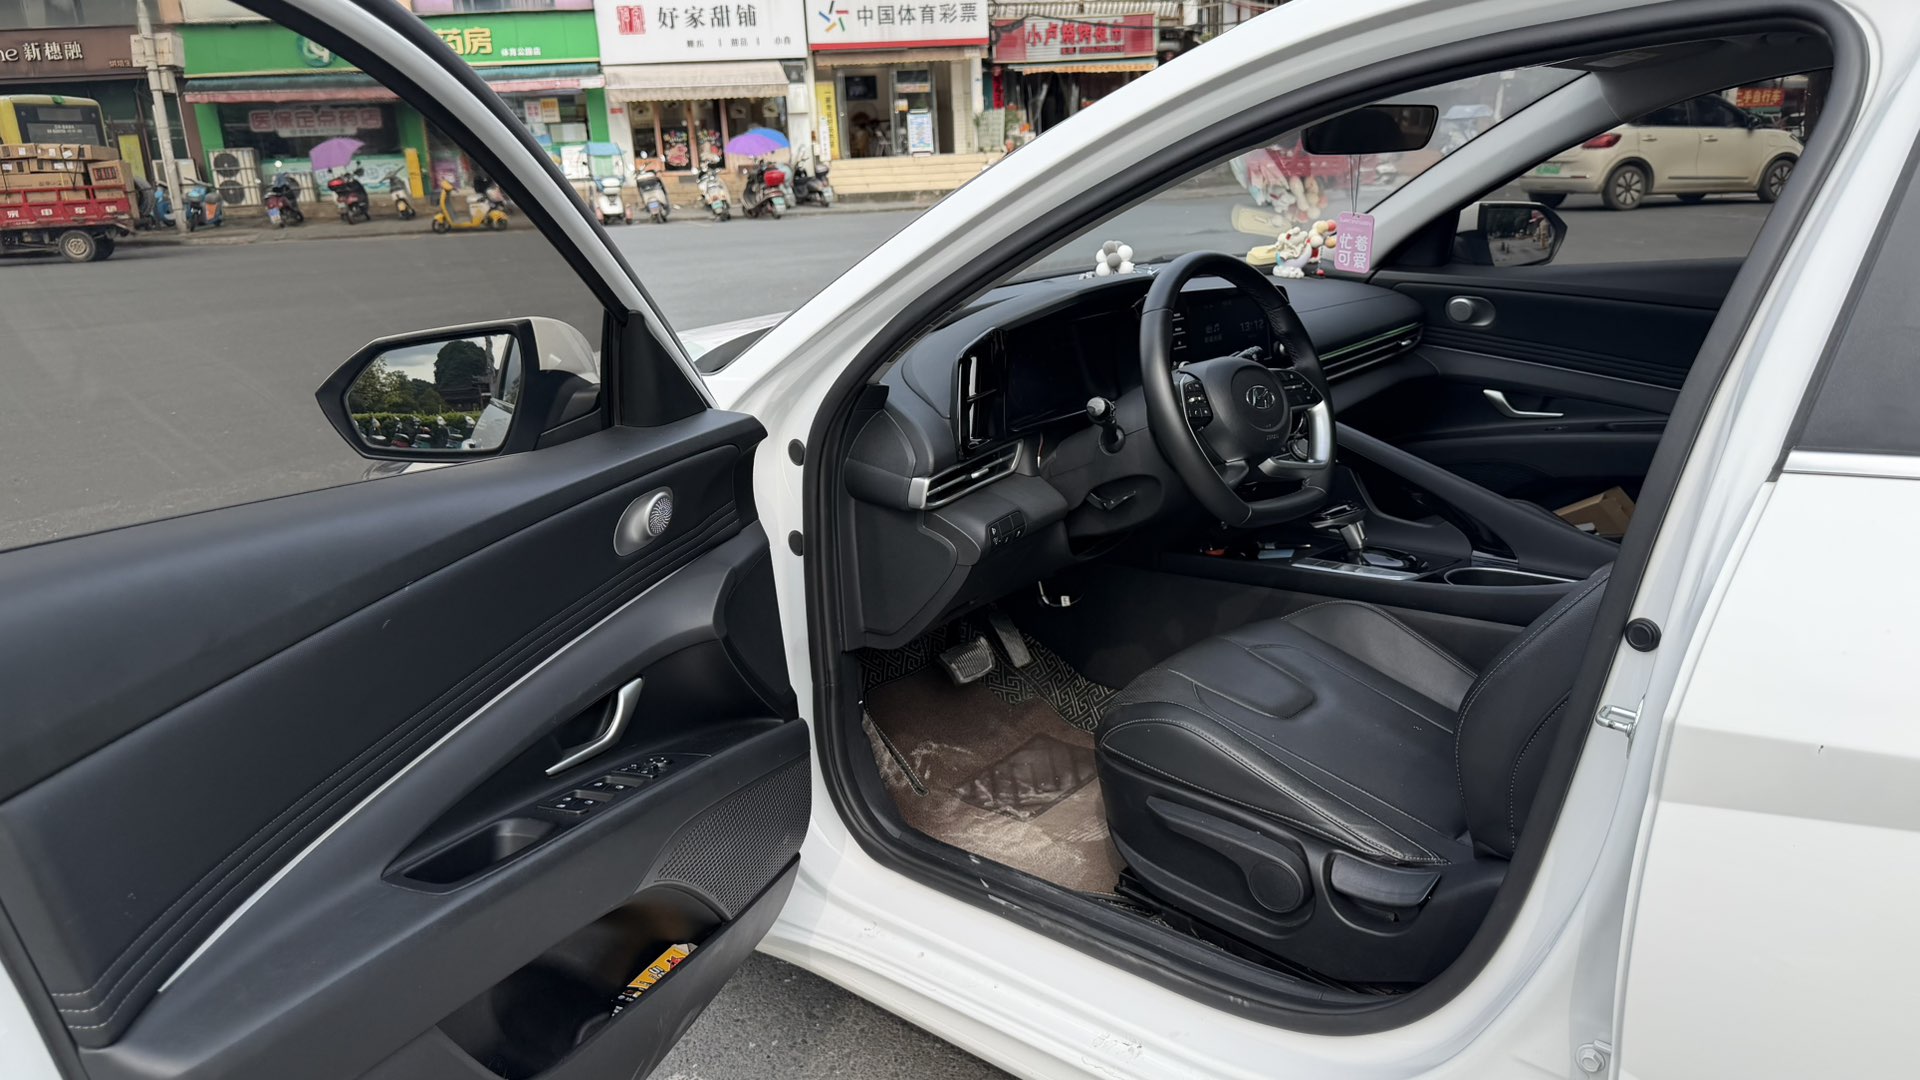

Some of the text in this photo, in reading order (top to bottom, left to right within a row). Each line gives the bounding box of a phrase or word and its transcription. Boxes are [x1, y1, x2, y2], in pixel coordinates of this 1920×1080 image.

[657, 4, 757, 29] 好家甜铺
[857, 2, 978, 27] 中国体育彩票
[23, 41, 83, 61] 新穗融
[433, 27, 493, 55] 药房
[1339, 233, 1368, 252] 忙着
[1338, 250, 1367, 269] 可爱
